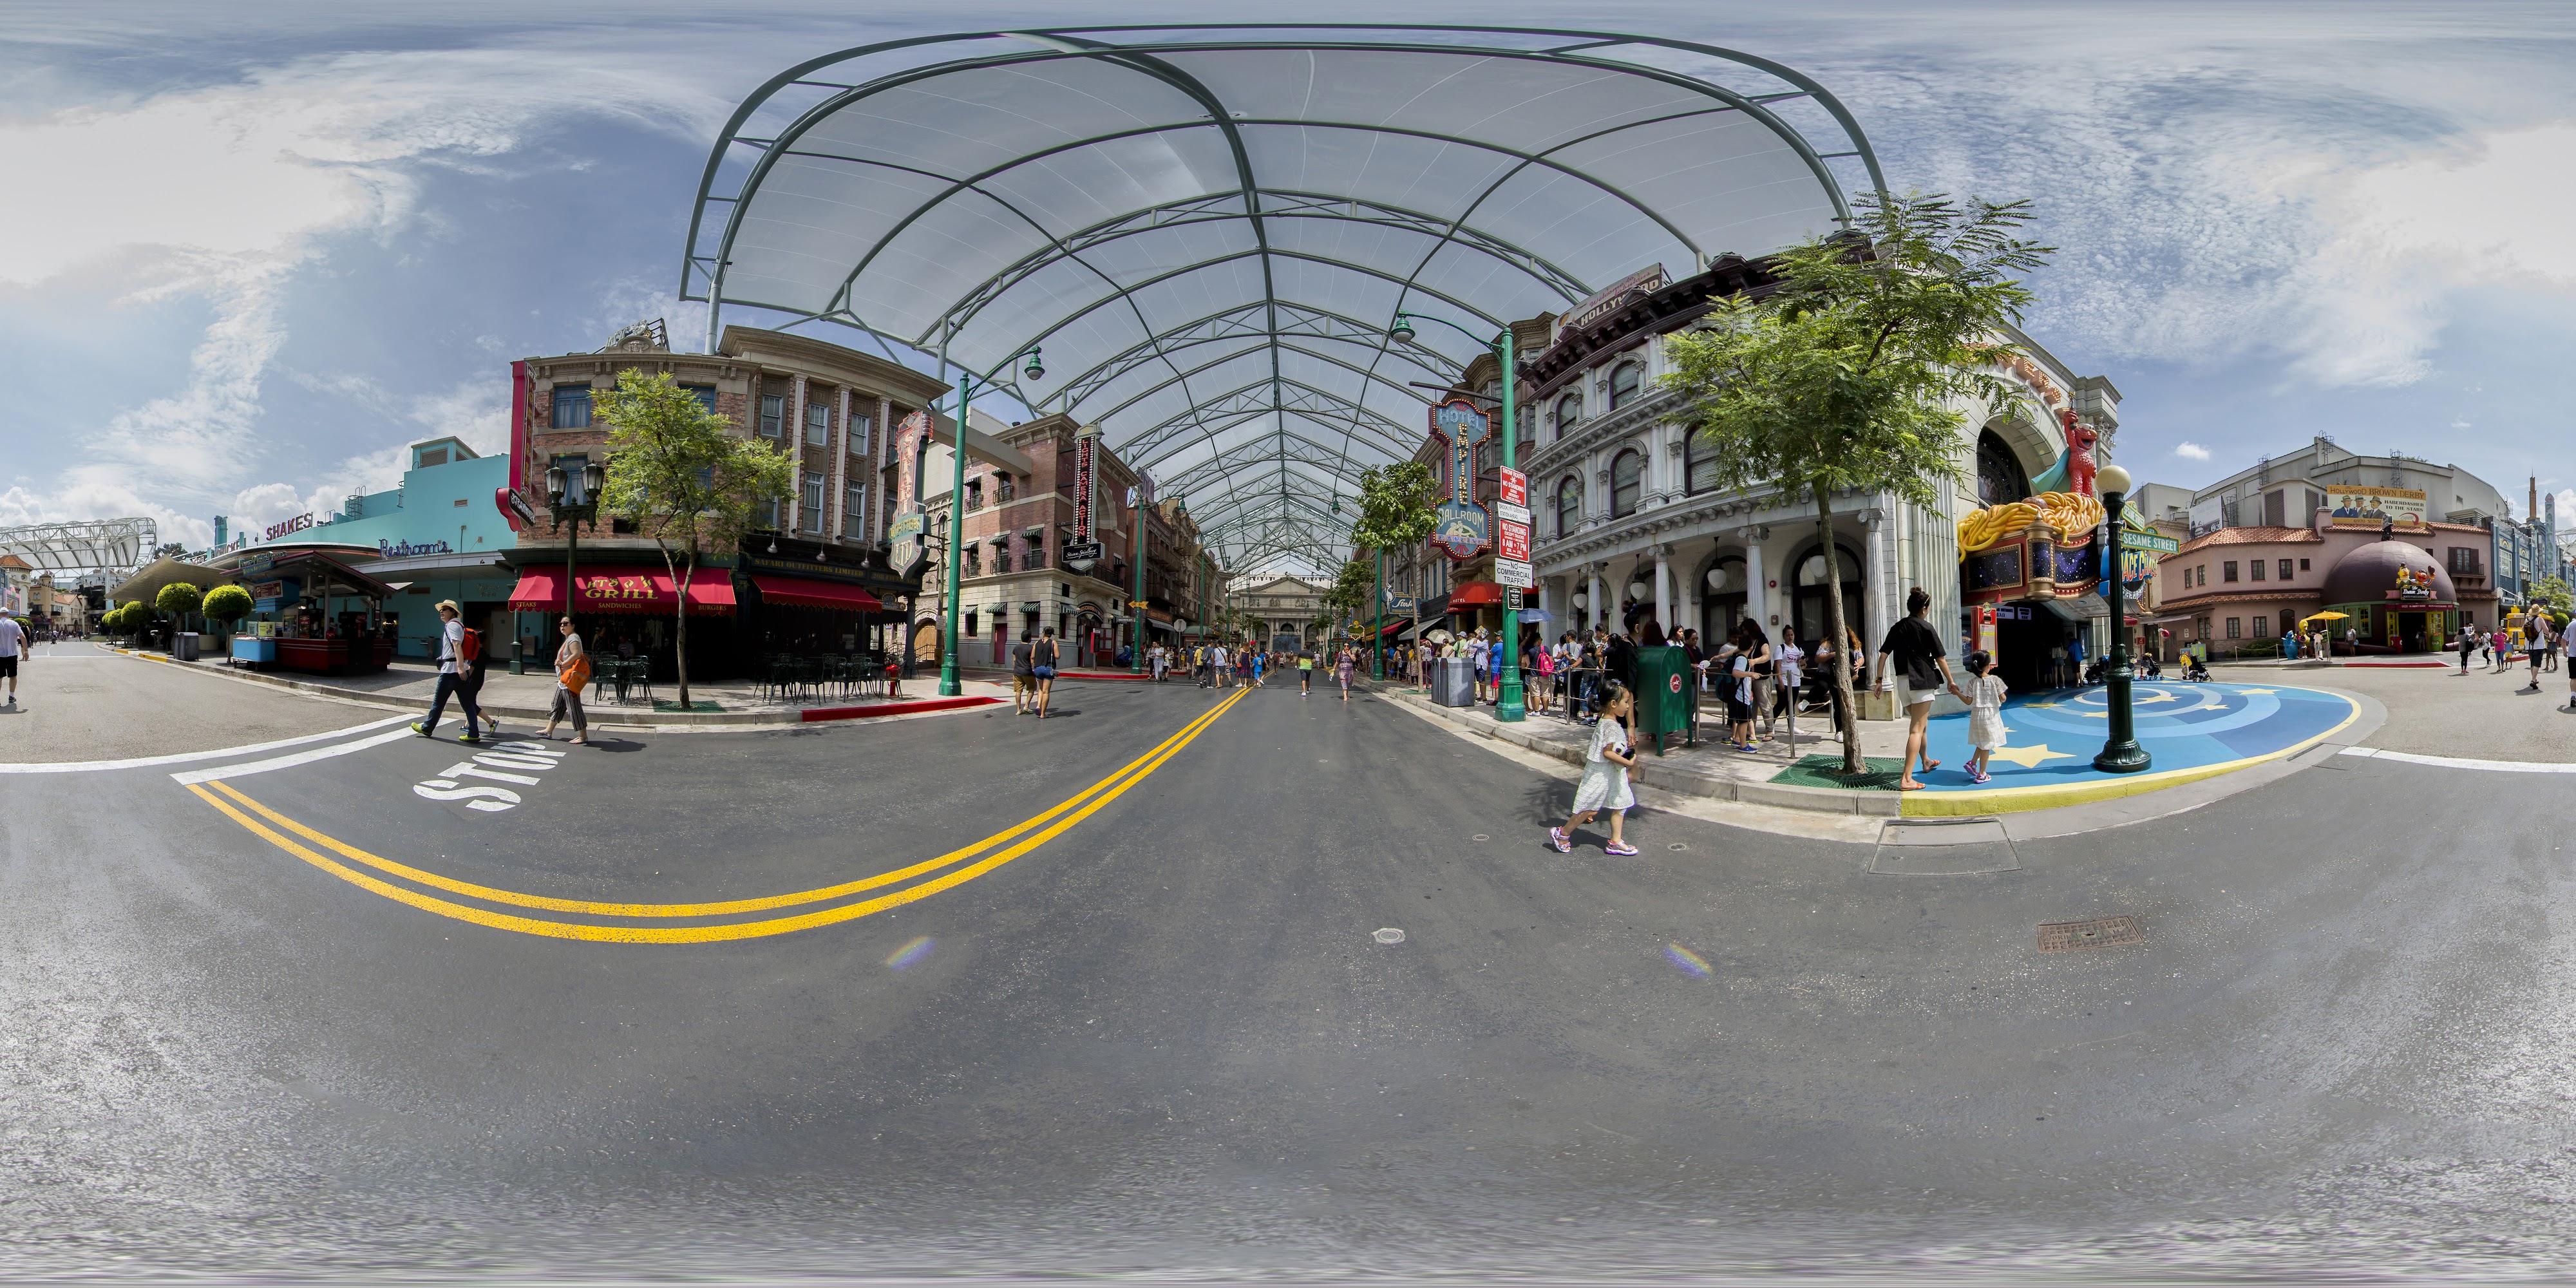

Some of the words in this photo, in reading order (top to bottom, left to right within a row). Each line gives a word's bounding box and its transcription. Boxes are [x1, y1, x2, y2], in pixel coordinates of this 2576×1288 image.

[1589, 283, 1624, 308] Welcome
[1439, 408, 1482, 432] HOTEL
[900, 430, 914, 515] SAFARI
[1457, 422, 1468, 506] EMPIRE
[1502, 468, 1513, 476] SNOW
[1513, 471, 1524, 480] ROUTE
[1079, 471, 1088, 501] CAMERA
[1508, 482, 1524, 493] STANDING
[2400, 490, 2425, 500] DERBY
[511, 493, 536, 524] STEAKHOUSE
[266, 513, 312, 541] SHAKES
[889, 516, 920, 540] OUTFITTERS
[1078, 505, 1086, 536] ACTION
[1438, 507, 1484, 535] BALLROOM
[1502, 522, 1508, 531] NO
[1508, 524, 1526, 536] STANDING
[379, 538, 453, 558] Restrooms
[1438, 534, 1485, 545] DANCING
[1506, 540, 1513, 548] AM
[1520, 543, 1526, 552] PM
[2123, 532, 2151, 547] SESAME
[2153, 536, 2177, 551] STREET
[895, 539, 912, 567] LTD
[1078, 546, 1097, 559] Spielberg
[755, 558, 784, 568] SAFARI
[786, 561, 833, 573] OUTFITTERS
[835, 567, 864, 578] LIMITED
[1497, 567, 1531, 579] COMMERCIAL
[587, 578, 620, 589] KT'S
[1504, 576, 1524, 585] TRAFFIC
[585, 589, 659, 600] GRILL
[412, 741, 567, 812] STOP
